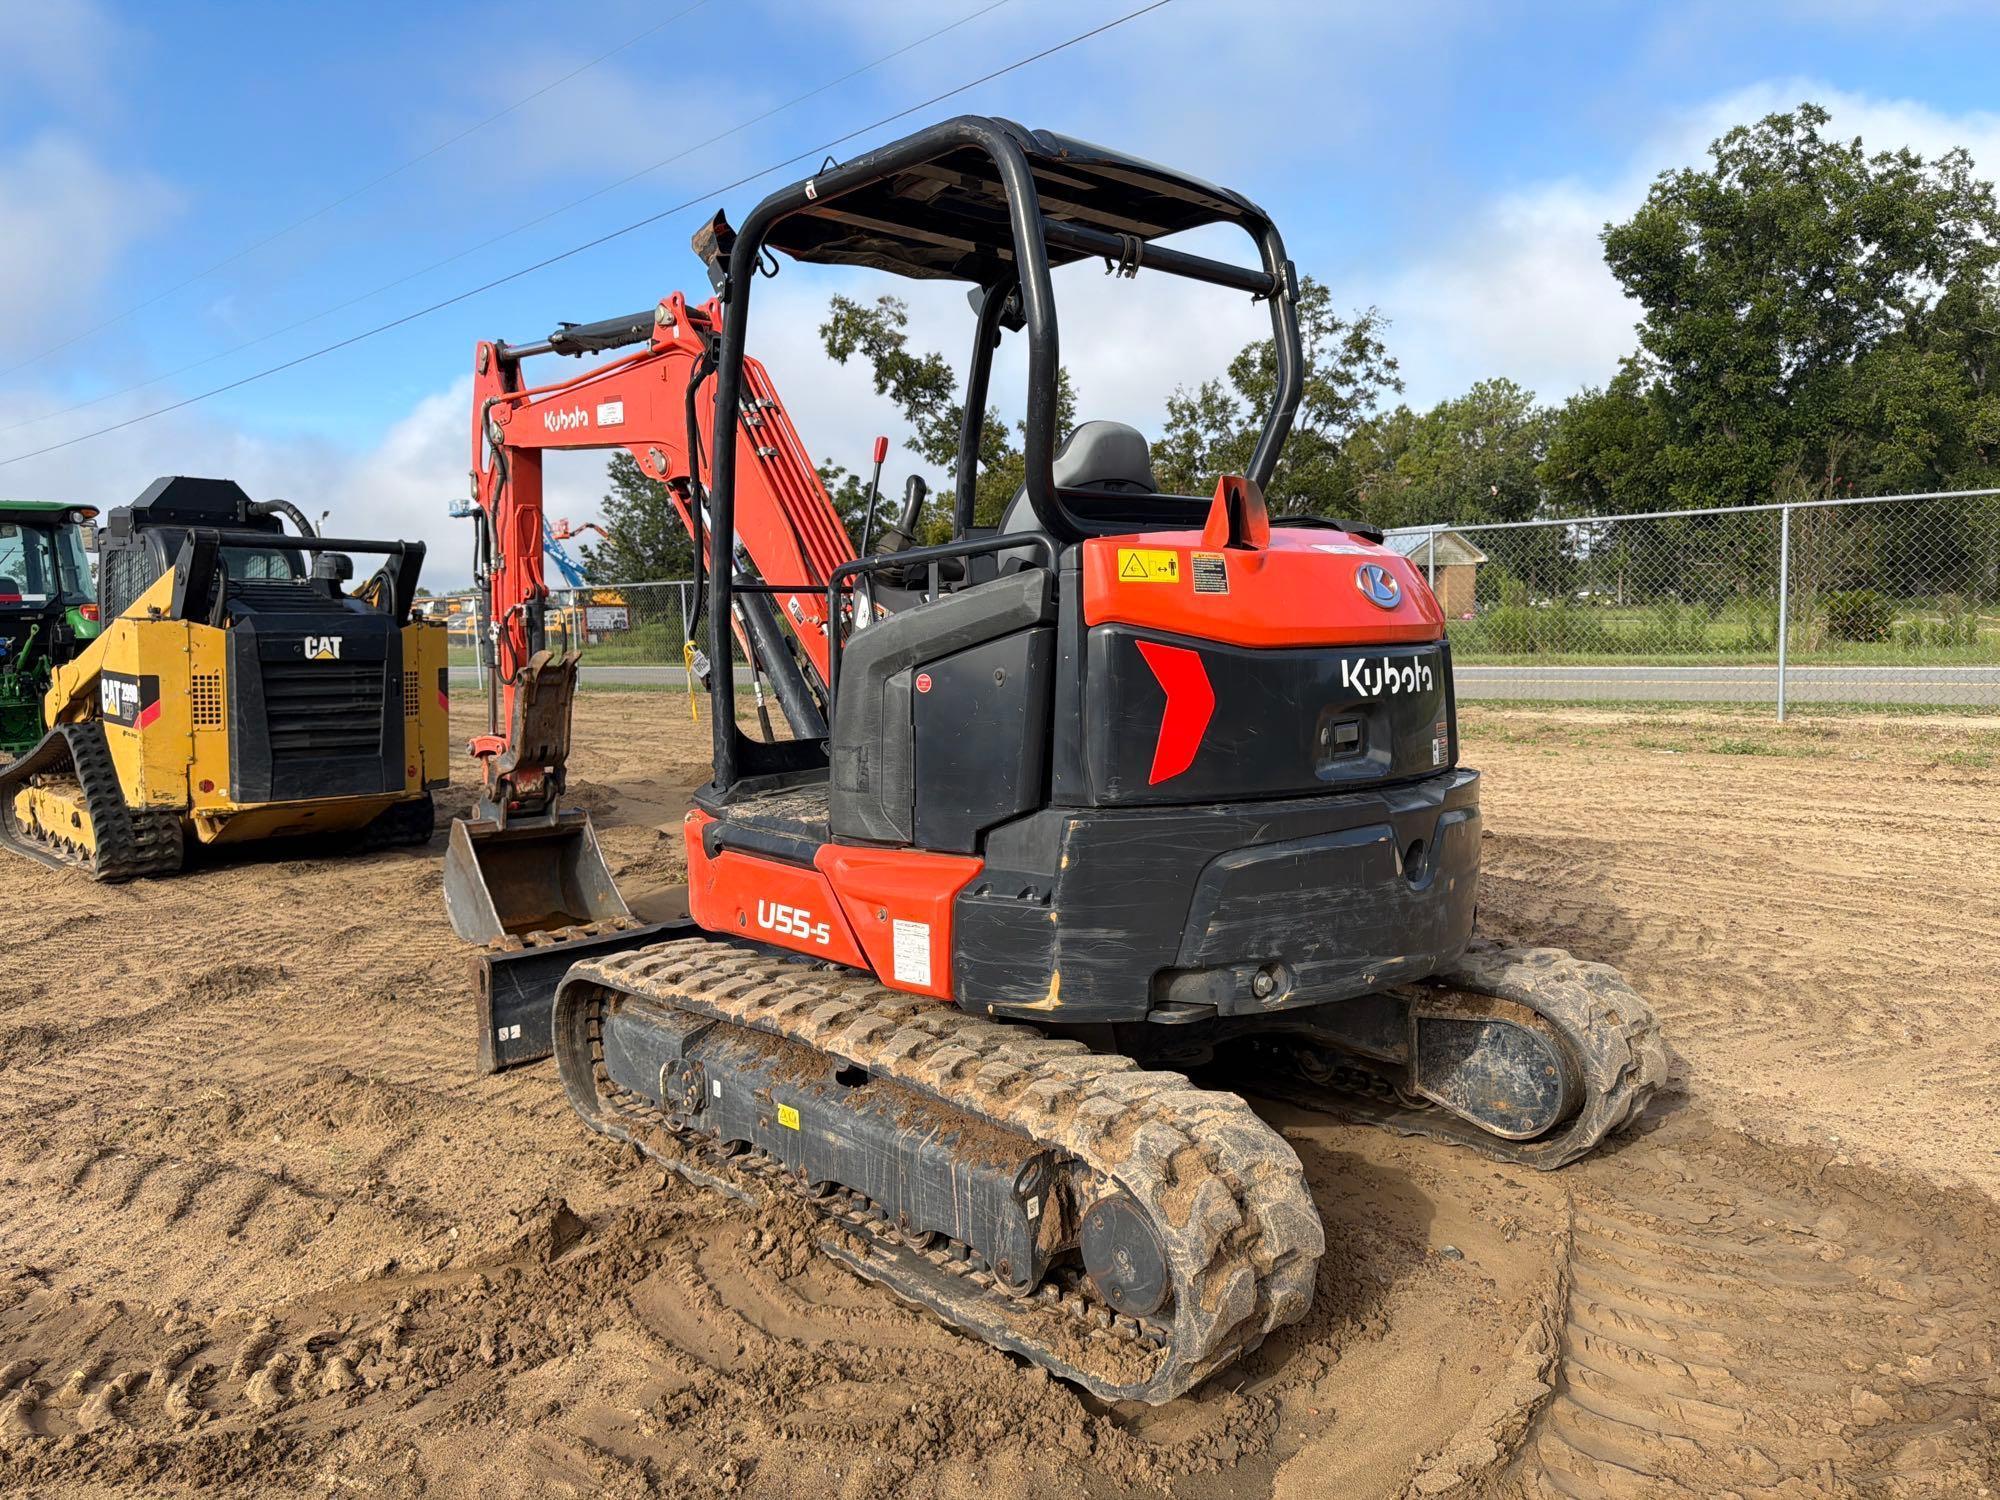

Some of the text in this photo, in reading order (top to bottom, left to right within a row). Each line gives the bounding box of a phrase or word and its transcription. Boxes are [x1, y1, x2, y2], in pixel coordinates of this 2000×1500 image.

[544, 405, 589, 432] Kubota
[304, 636, 343, 660] CAT
[1341, 656, 1433, 697] Kubota
[101, 678, 121, 716] CAT
[757, 899, 830, 945] U55-5
